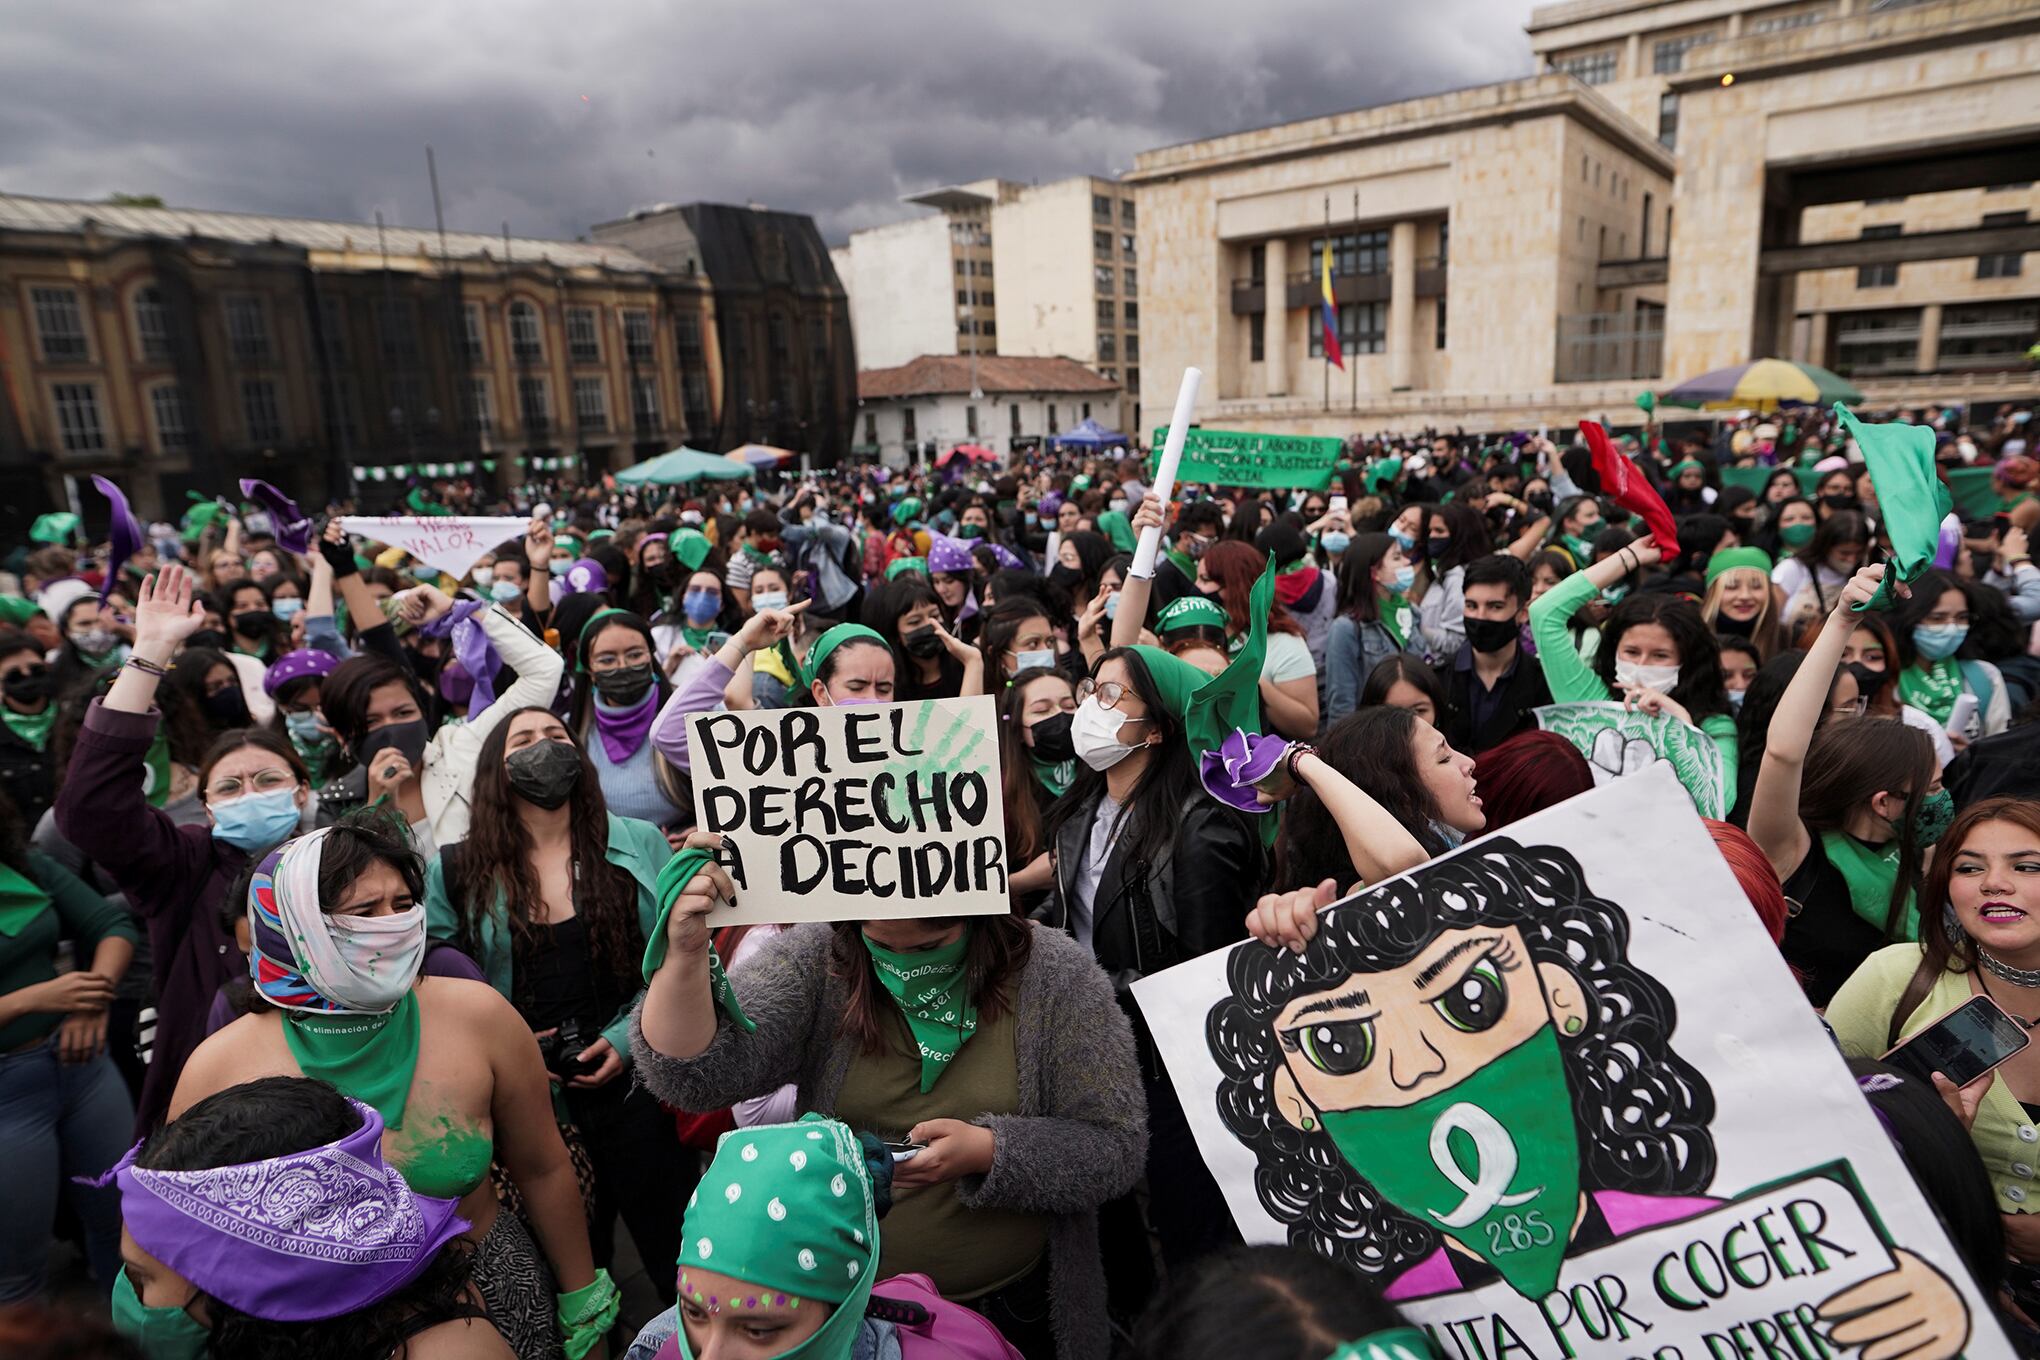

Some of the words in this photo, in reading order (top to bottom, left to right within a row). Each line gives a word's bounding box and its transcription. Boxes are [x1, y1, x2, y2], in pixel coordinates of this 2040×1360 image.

[1217, 466, 1264, 482] SOCIAL
[402, 530, 484, 558] VALOR
[695, 711, 832, 780] POR
[845, 708, 924, 764] EL
[702, 770, 988, 836] DERECHO
[780, 834, 1006, 899] DECIDIR
[313, 1024, 368, 1034] eliminación
[1537, 1273, 1654, 1360] POR
[1653, 1198, 1857, 1311] COGER
